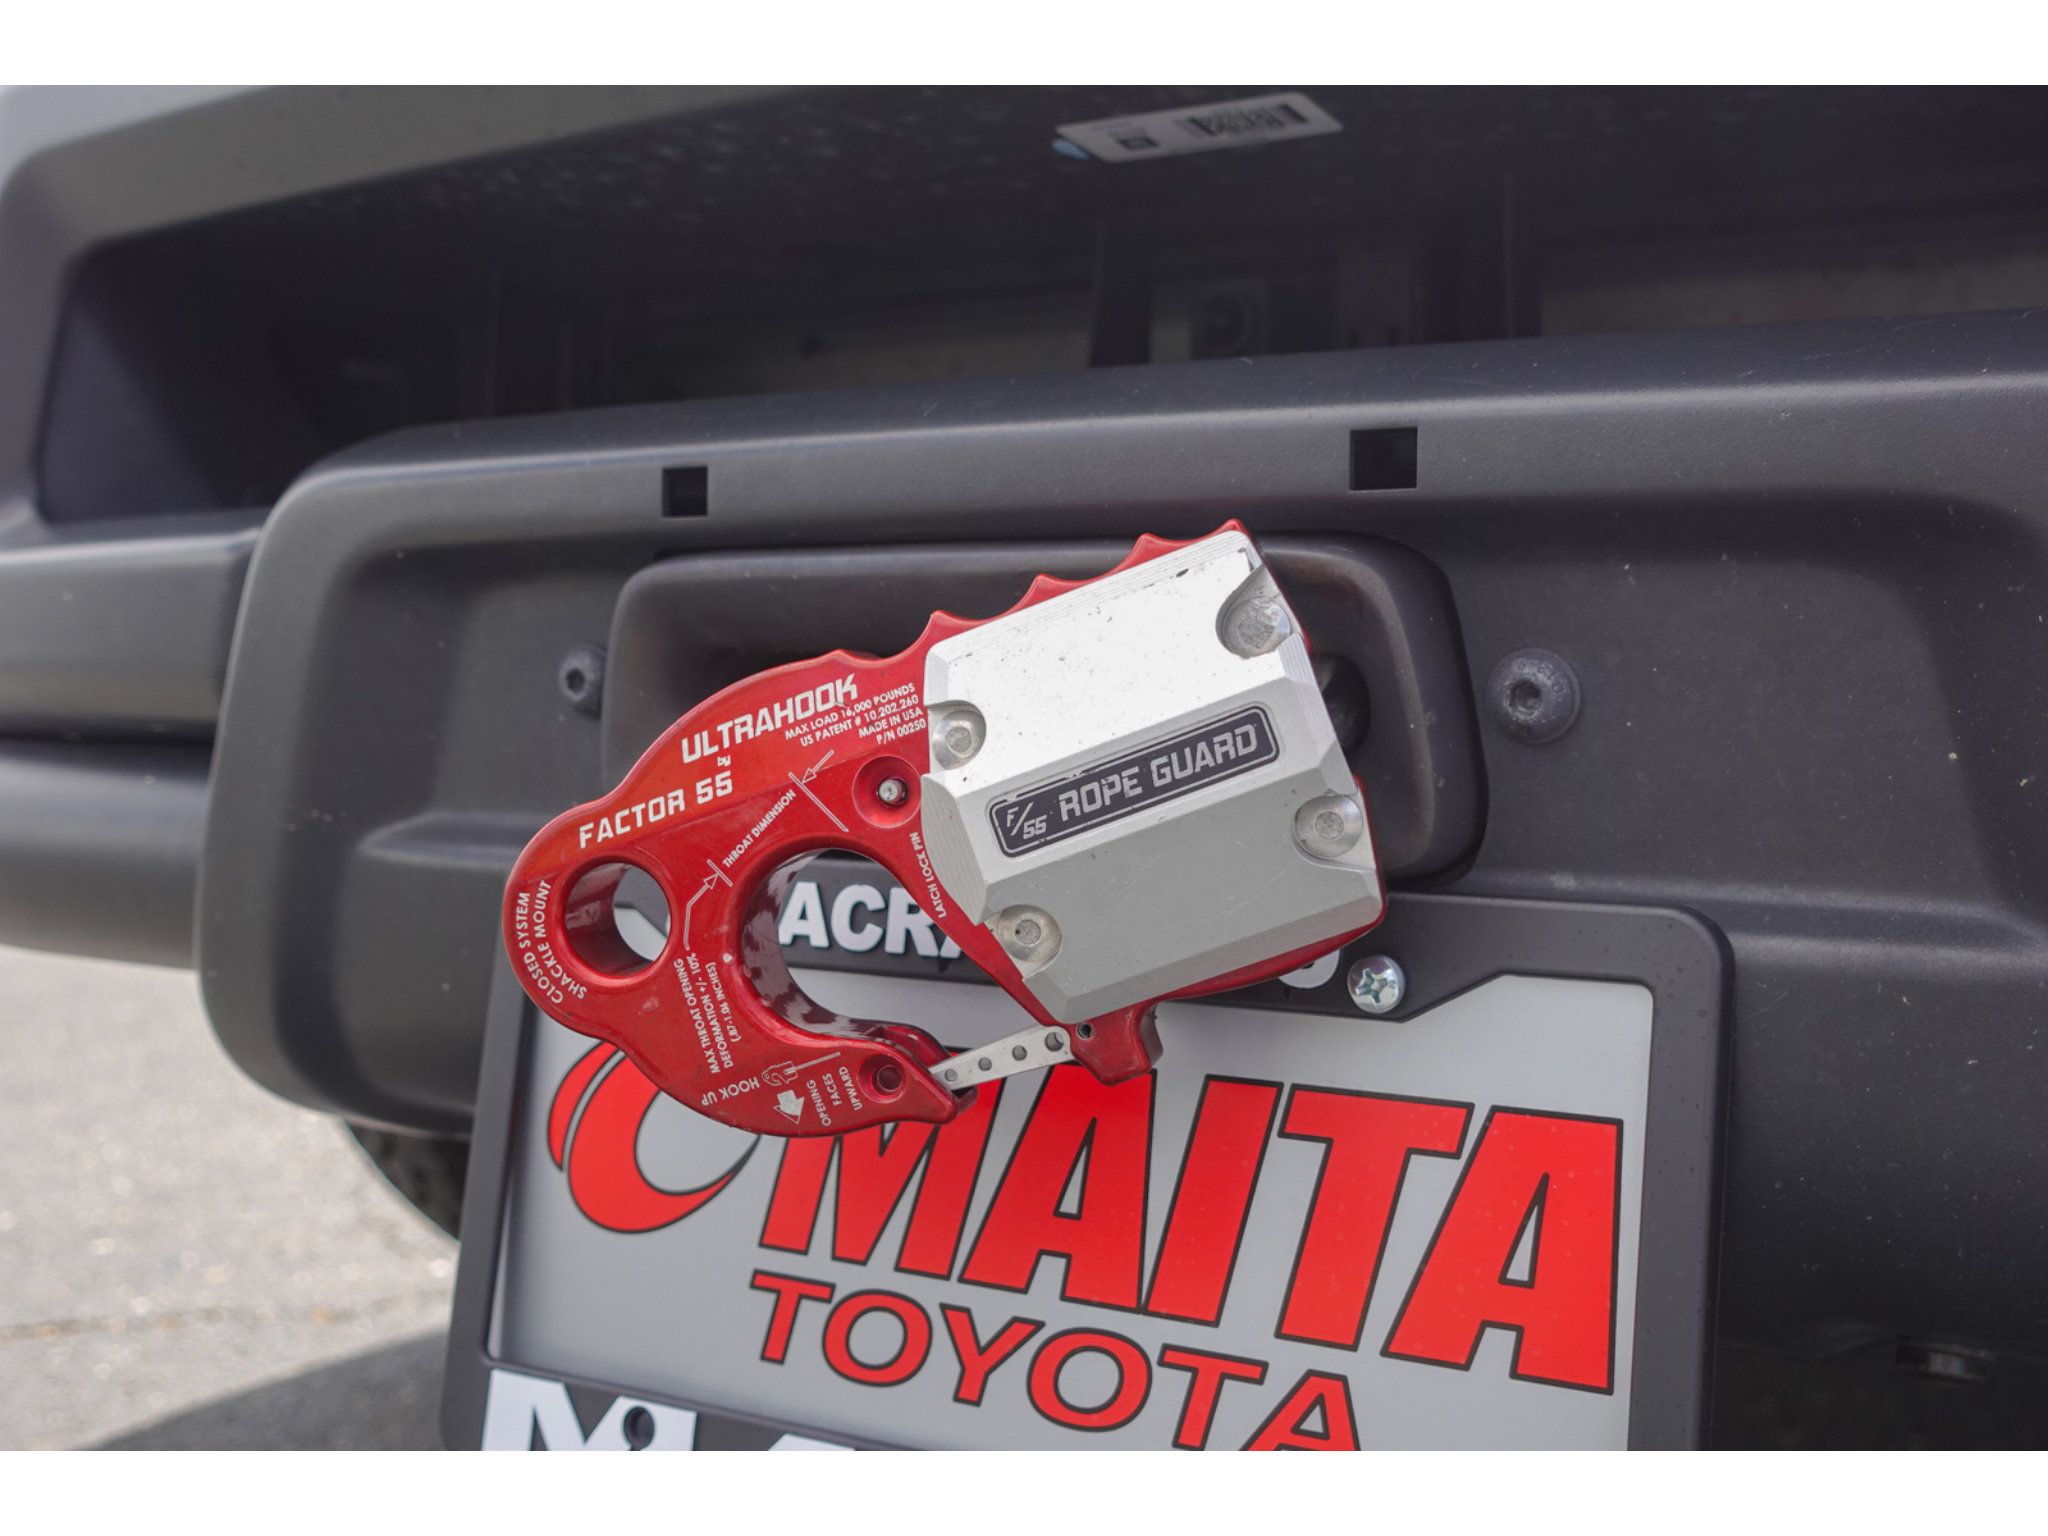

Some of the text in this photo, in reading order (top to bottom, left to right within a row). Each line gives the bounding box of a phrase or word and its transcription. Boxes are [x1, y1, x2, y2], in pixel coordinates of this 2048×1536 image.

[681, 673, 858, 764] ULTRAHOOK
[785, 682, 915, 740] MAX LOAD 16,000 POUNDS
[800, 735, 814, 747] US
[816, 719, 852, 742] PATENT
[858, 707, 923, 738] MADE IN USA
[876, 718, 926, 745] P/N 00250
[579, 770, 733, 849] FACTOR 55
[1059, 766, 1143, 821] ROPE
[1150, 724, 1257, 788] GUARD
[722, 789, 796, 868] THROAT DIMENSION
[910, 832, 946, 918] LATCH LOCK PIN
[516, 892, 563, 1003] CLOSED SYSTEM
[533, 880, 587, 999] SHACKLE MOUNT
[674, 958, 721, 1074] MAX THROAT OPENING
[701, 994, 734, 1069] DEFORMATION
[701, 1076, 760, 1106] HOOK UP
[806, 1079, 832, 1126] OPENING
[822, 1073, 842, 1106] FACES
[838, 1066, 863, 1111] UPWARD
[758, 1046, 1623, 1396] MAITA
[750, 1269, 1361, 1450] TOYOTA
